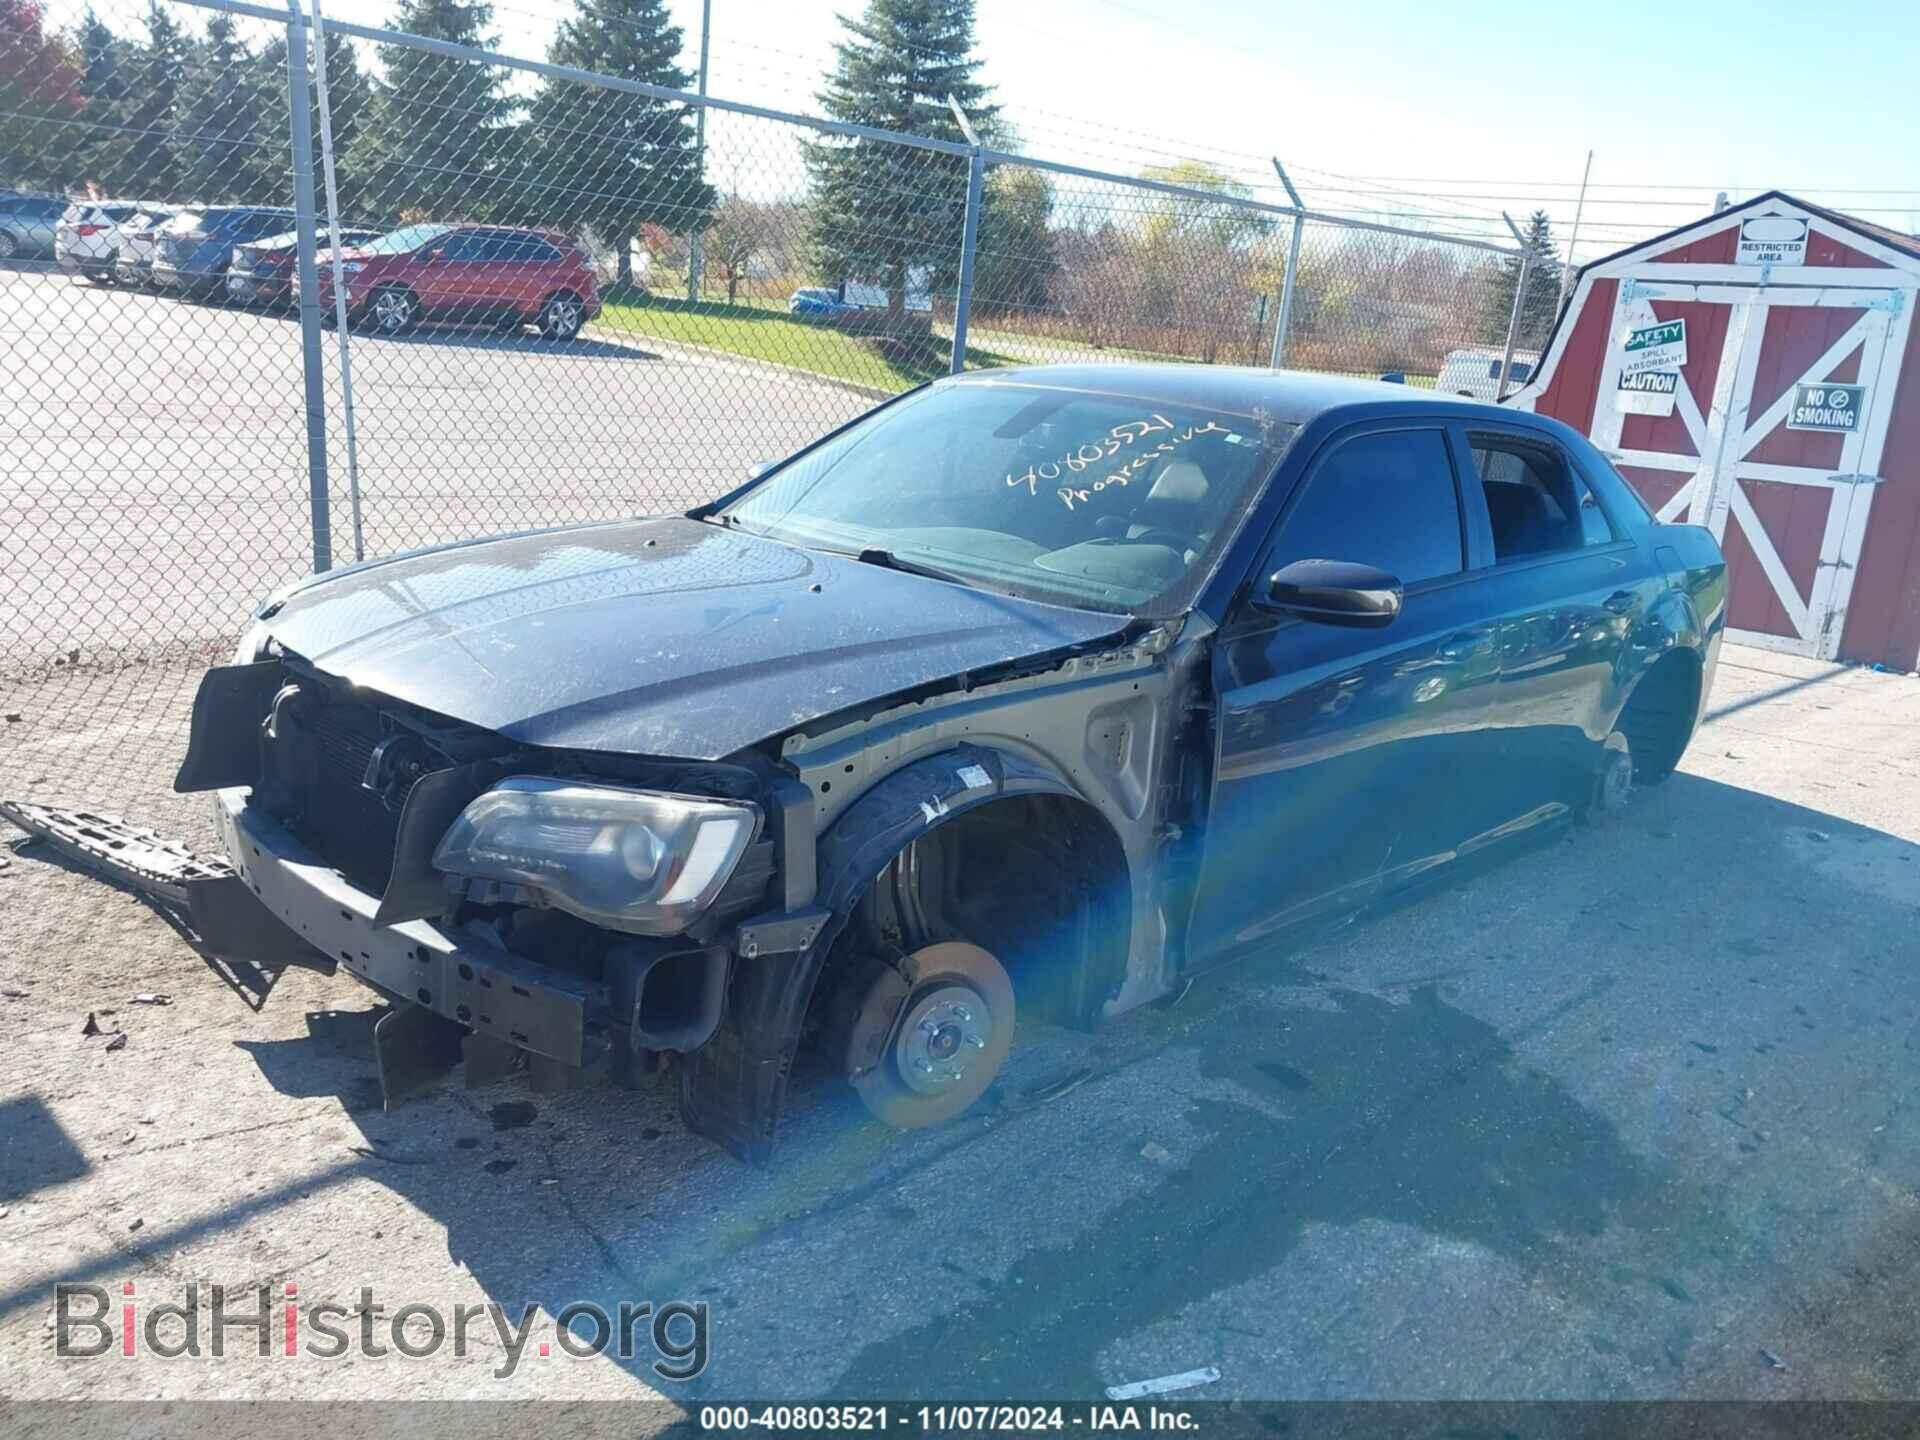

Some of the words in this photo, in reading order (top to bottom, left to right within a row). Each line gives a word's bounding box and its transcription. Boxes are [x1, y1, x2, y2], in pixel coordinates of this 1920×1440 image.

[1741, 243, 1802, 252] RESTRICTED
[1757, 253, 1782, 261] AREA
[1626, 324, 1681, 347] SAFETY
[1627, 354, 1682, 371] ABSORBANT
[1641, 348, 1667, 360] SPILL
[1621, 371, 1675, 392] CAUTION
[1806, 389, 1825, 407] NO
[1796, 406, 1854, 427] SMOKING
